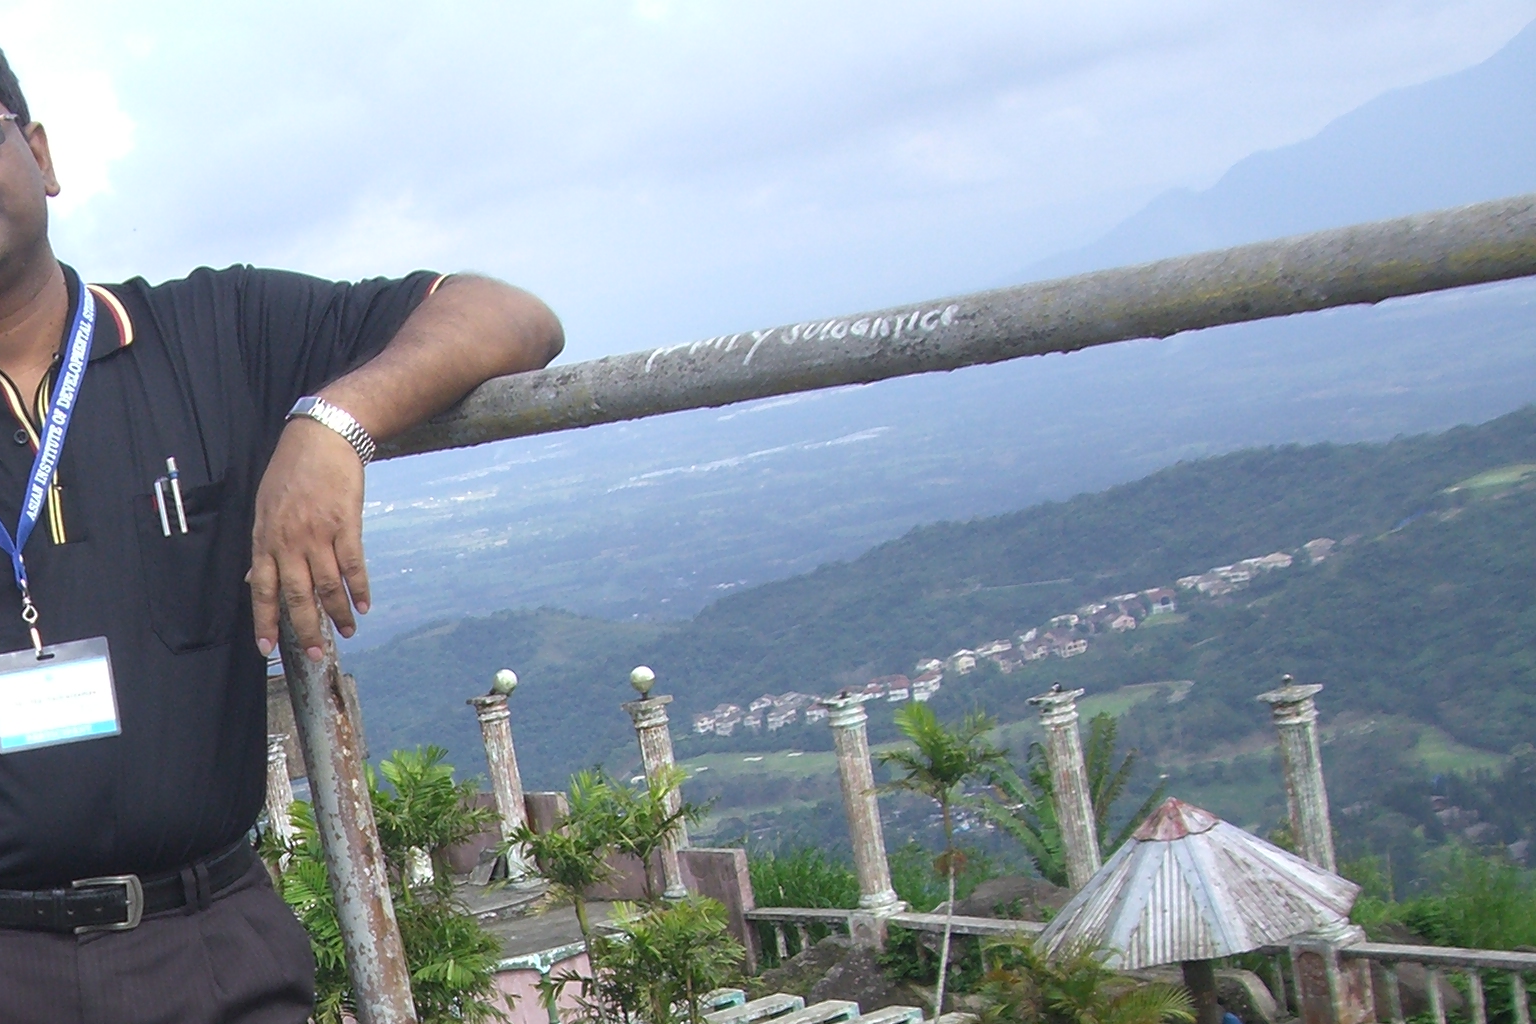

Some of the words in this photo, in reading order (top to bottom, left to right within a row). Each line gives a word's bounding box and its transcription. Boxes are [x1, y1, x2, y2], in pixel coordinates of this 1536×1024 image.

[56, 320, 92, 410] DEVELOPMENTAL
[51, 407, 67, 426] OF
[34, 424, 63, 486] INSTITUTE
[26, 483, 44, 522] ASIAN
